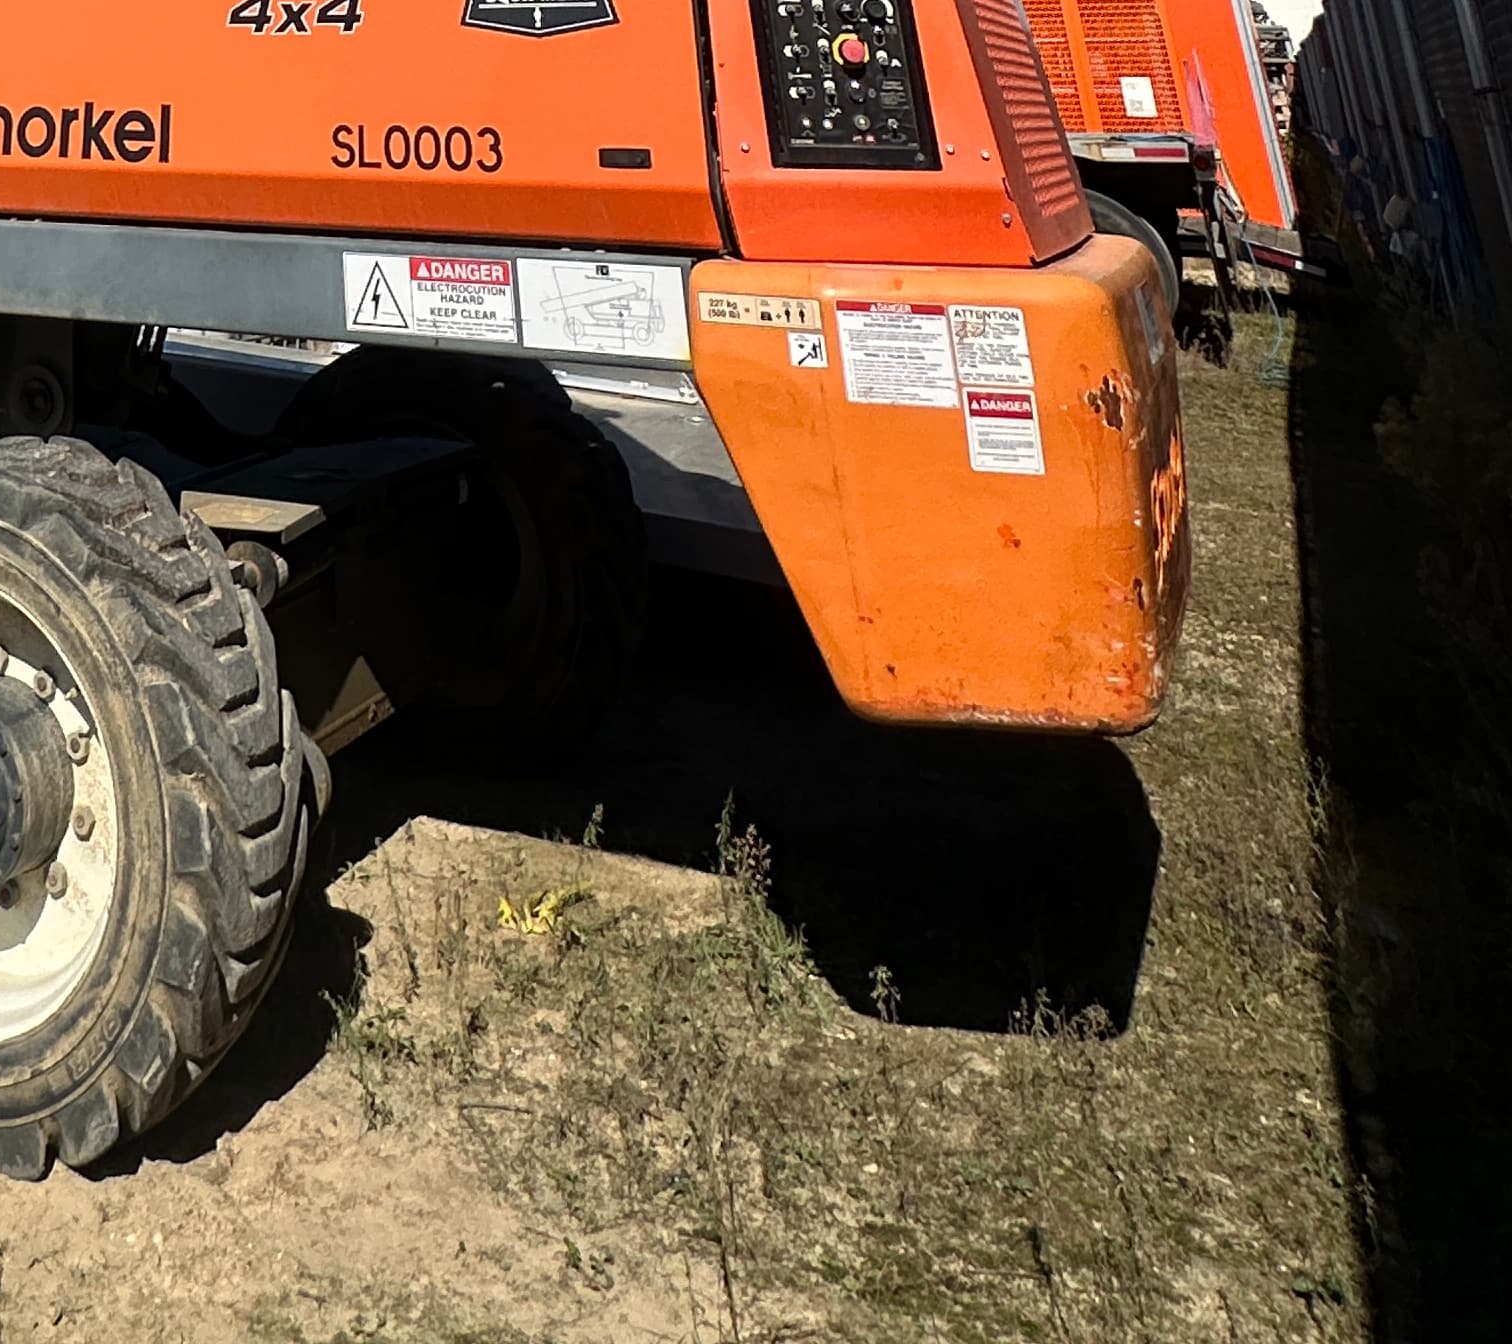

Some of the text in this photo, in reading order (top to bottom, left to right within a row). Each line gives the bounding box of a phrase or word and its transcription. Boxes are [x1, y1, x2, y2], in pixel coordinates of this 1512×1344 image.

[331, 124, 503, 173] SL0003
[431, 262, 505, 282] DANGER
[417, 282, 506, 296] ELECTROCUTION
[440, 293, 485, 305] HAZARD
[429, 307, 497, 320] KEEP CLEAR
[954, 309, 1019, 321] ATTENTION
[980, 399, 1031, 412] DANGER
